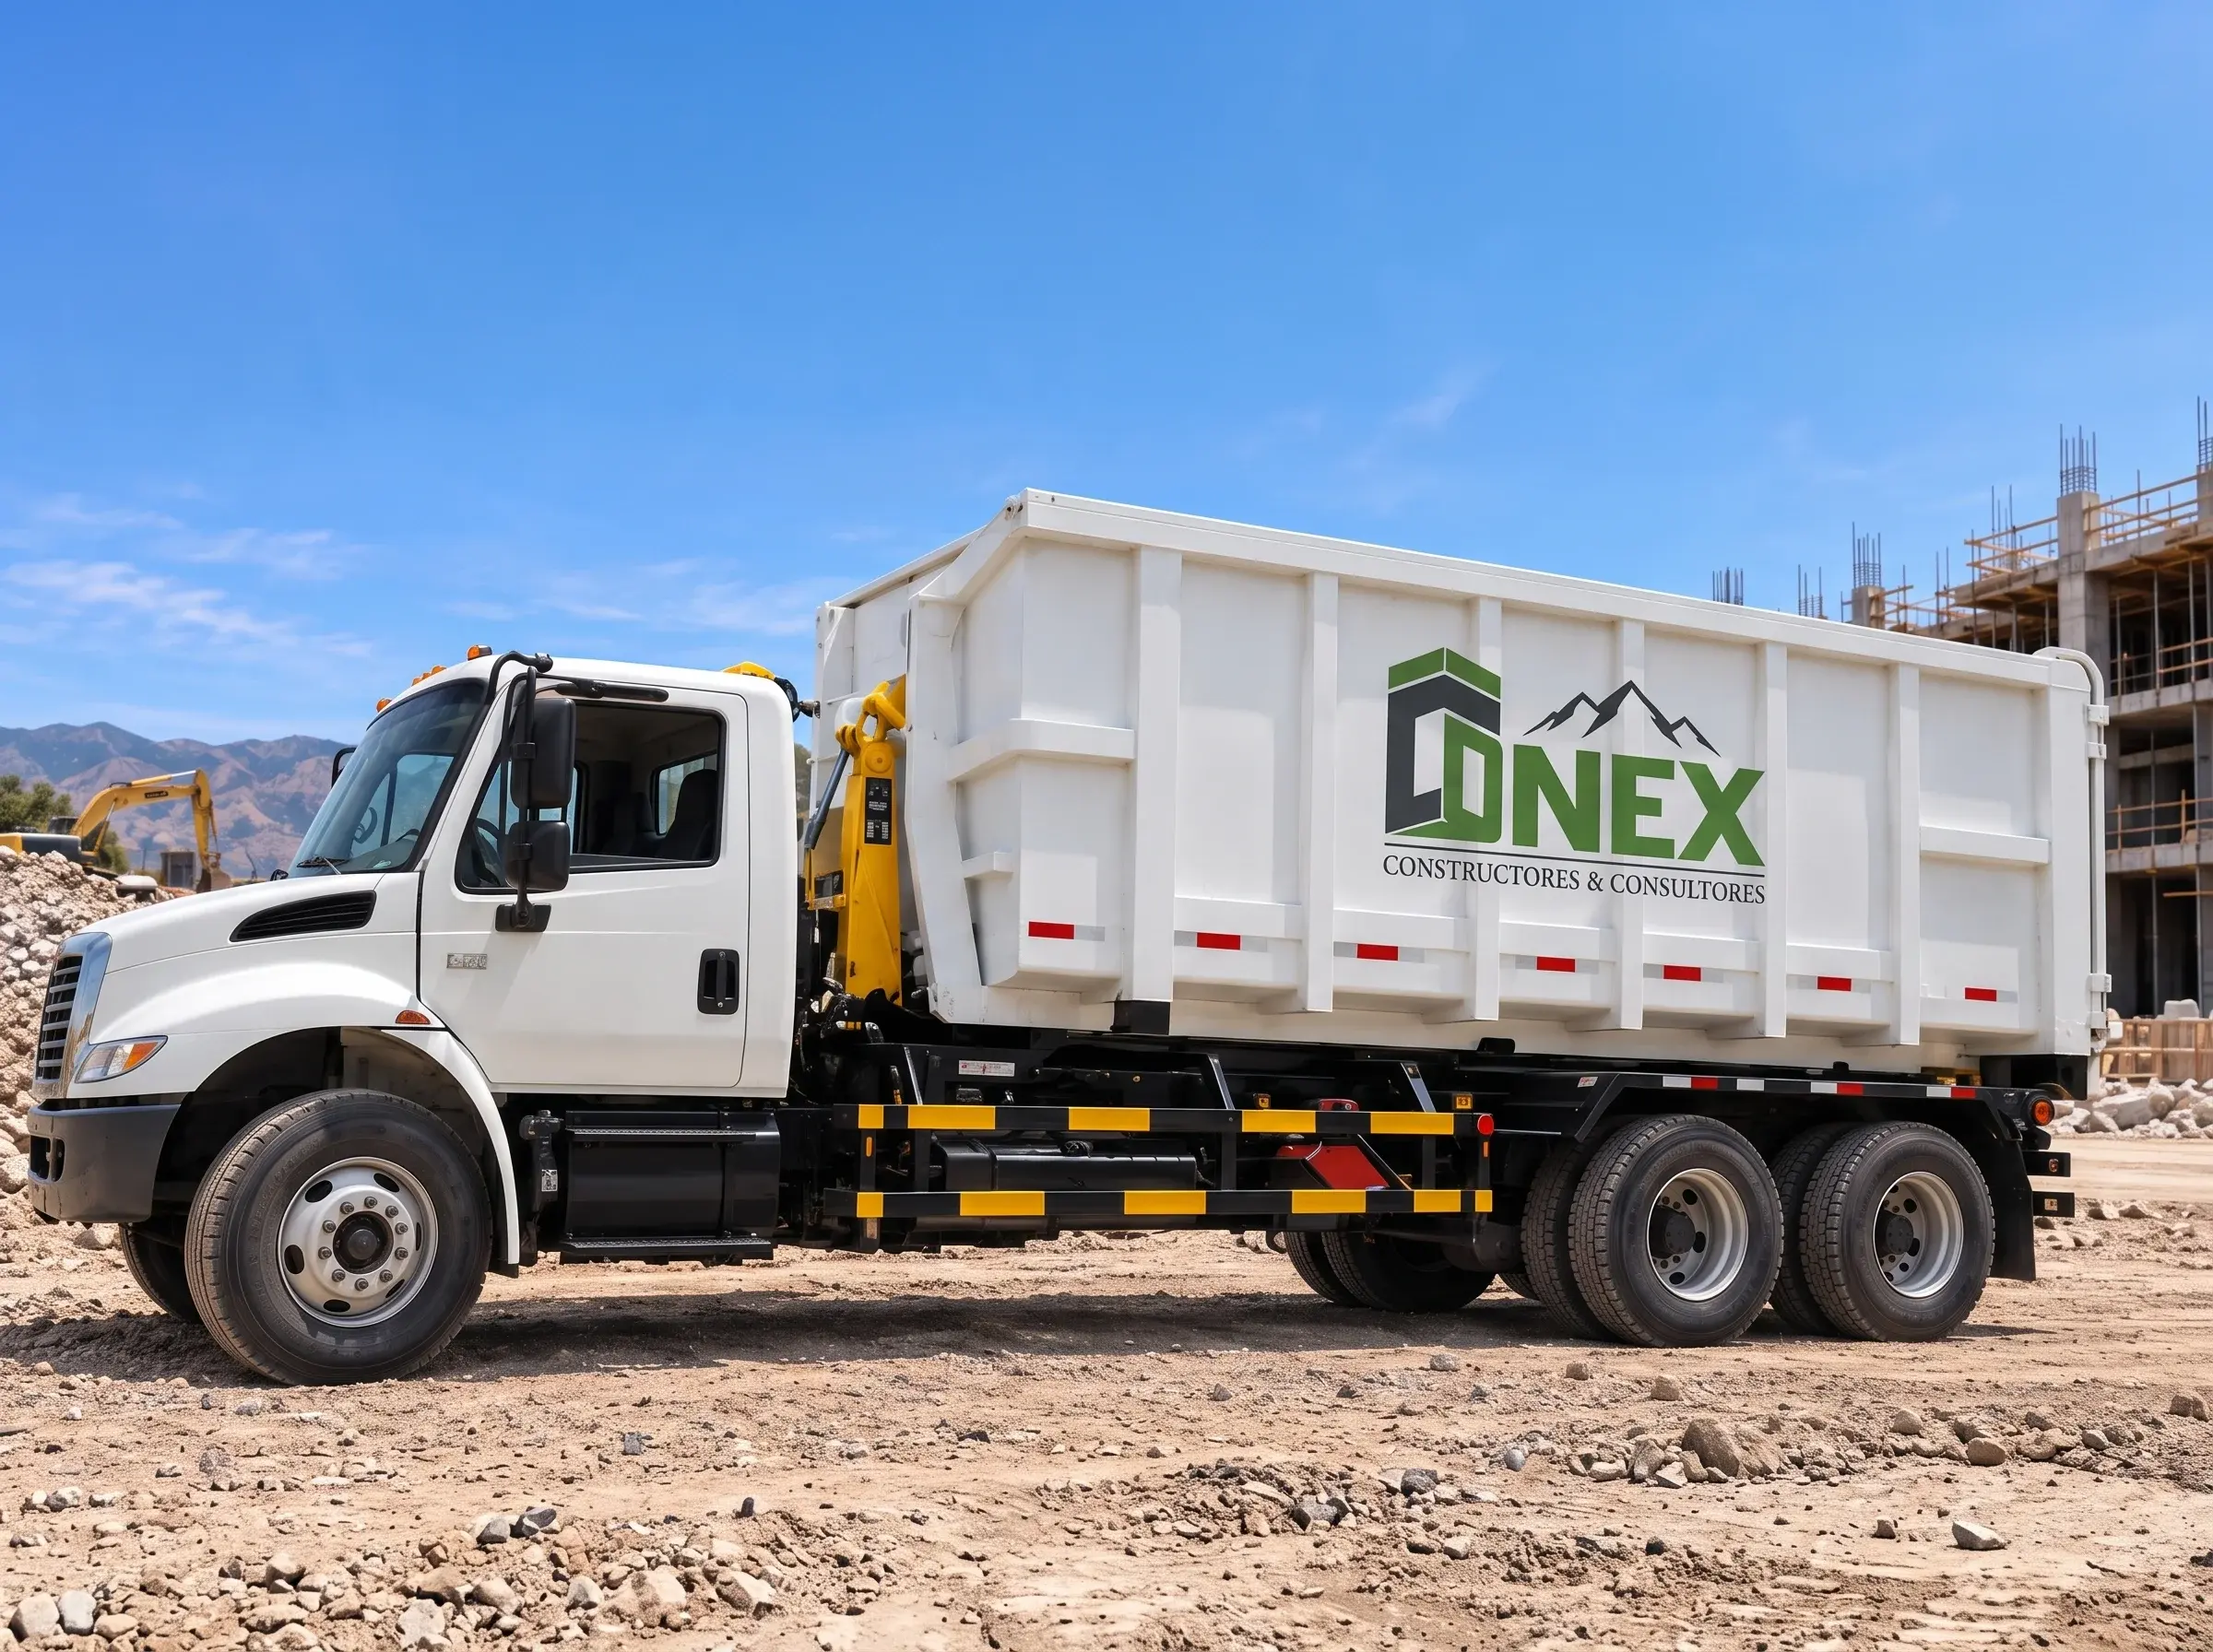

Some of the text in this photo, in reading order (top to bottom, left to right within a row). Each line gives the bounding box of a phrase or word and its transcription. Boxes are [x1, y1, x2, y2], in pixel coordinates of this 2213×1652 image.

[1383, 855, 1766, 904] CONSTRUCTORES & CONSULTORES
